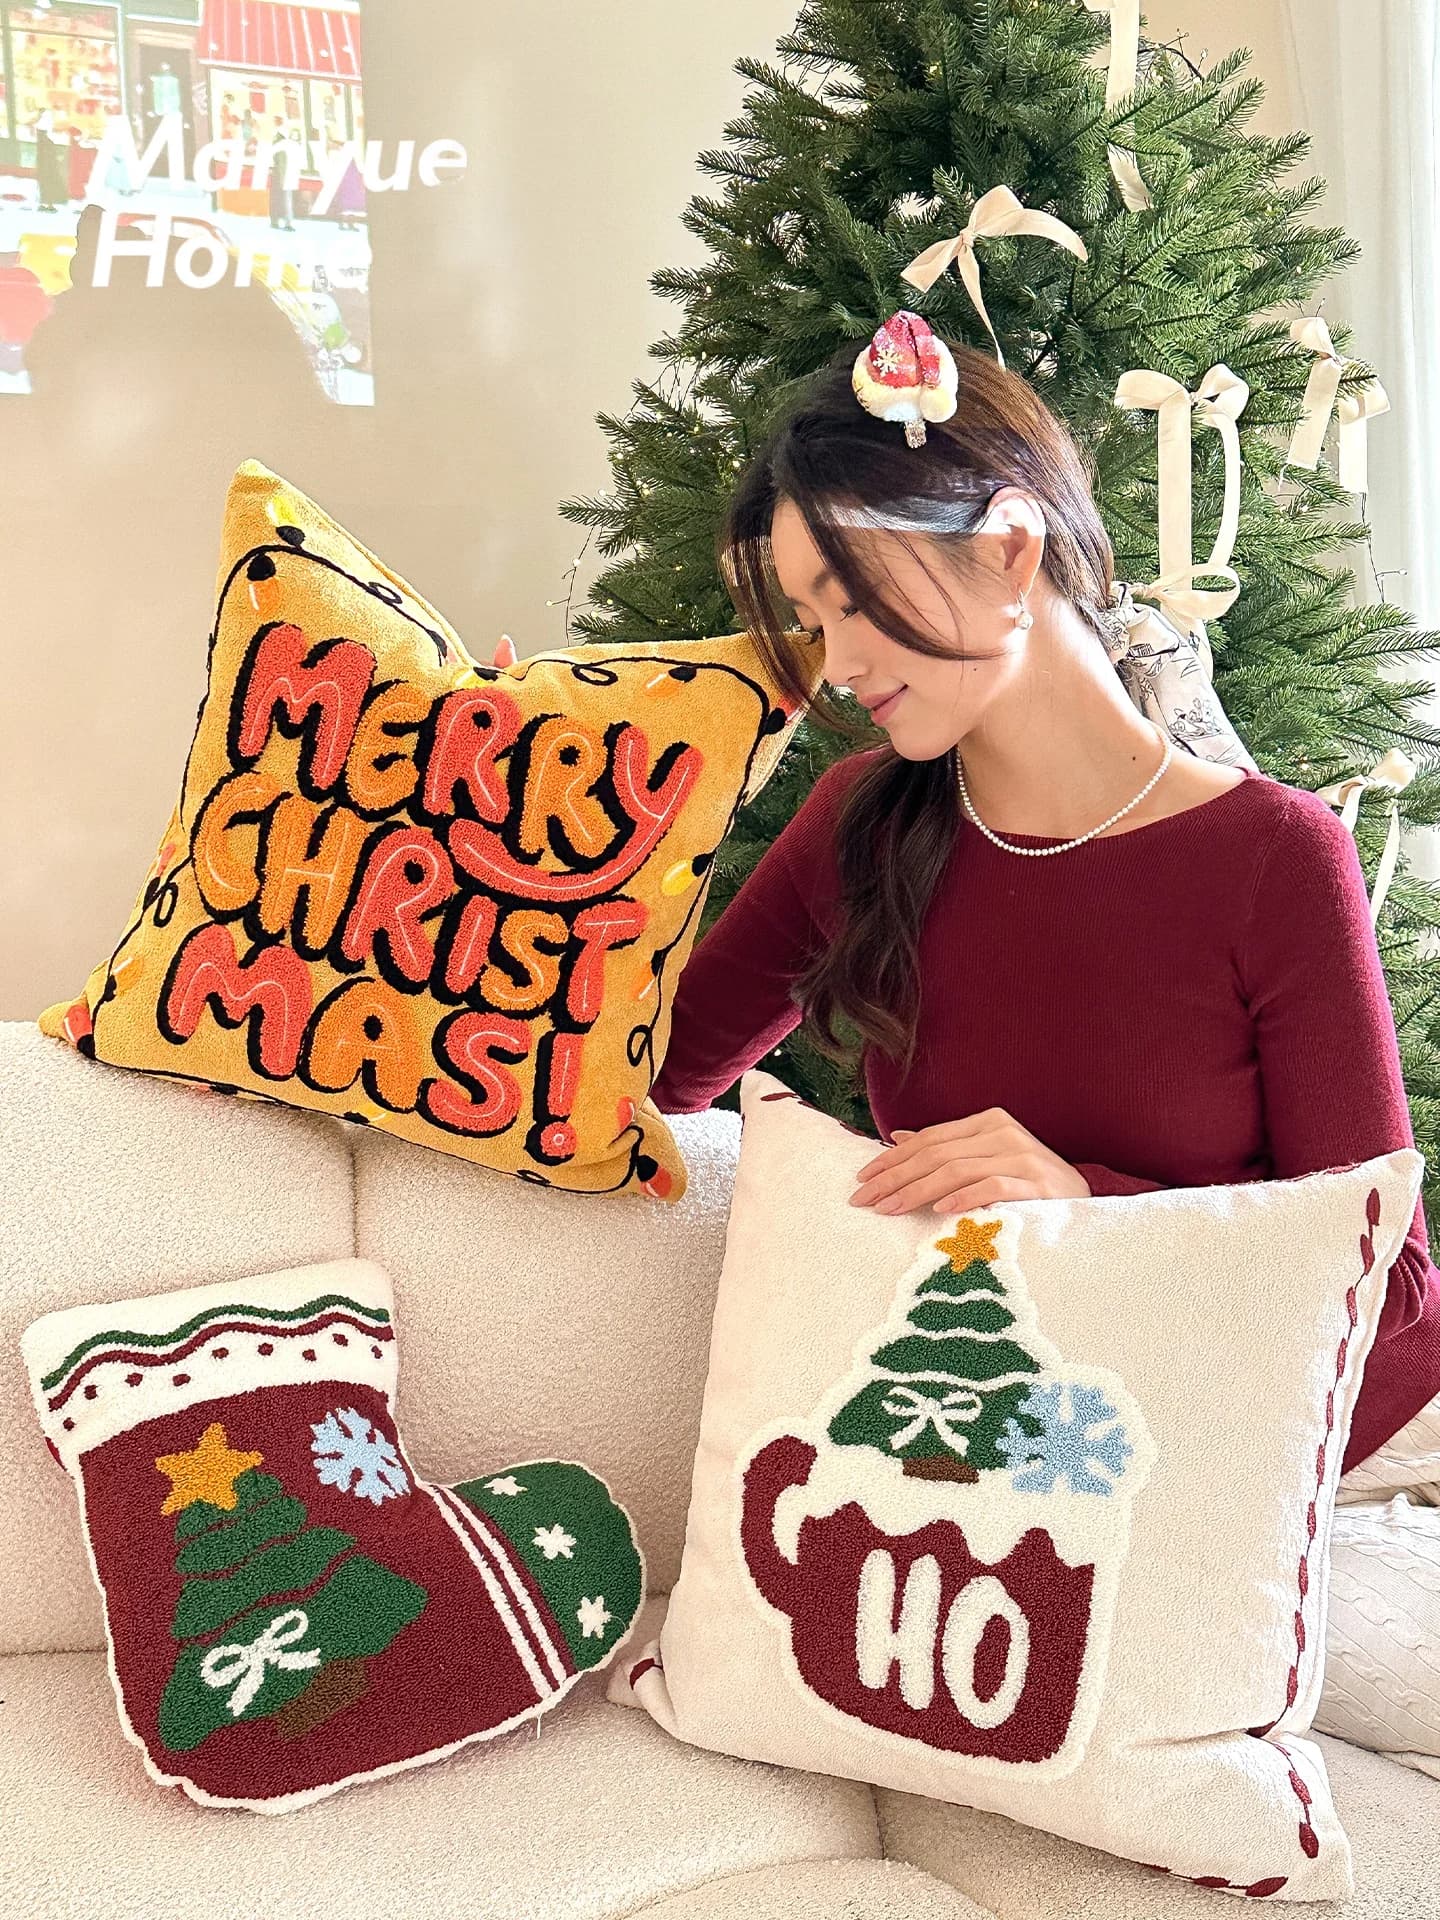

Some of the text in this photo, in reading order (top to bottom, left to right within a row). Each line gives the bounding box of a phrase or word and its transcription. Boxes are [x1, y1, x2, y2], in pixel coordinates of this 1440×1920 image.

[228, 621, 704, 902] MERRY
[191, 771, 648, 1031] CHRIST
[157, 922, 578, 1165] MAS!
[855, 1548, 1031, 1730] HO
